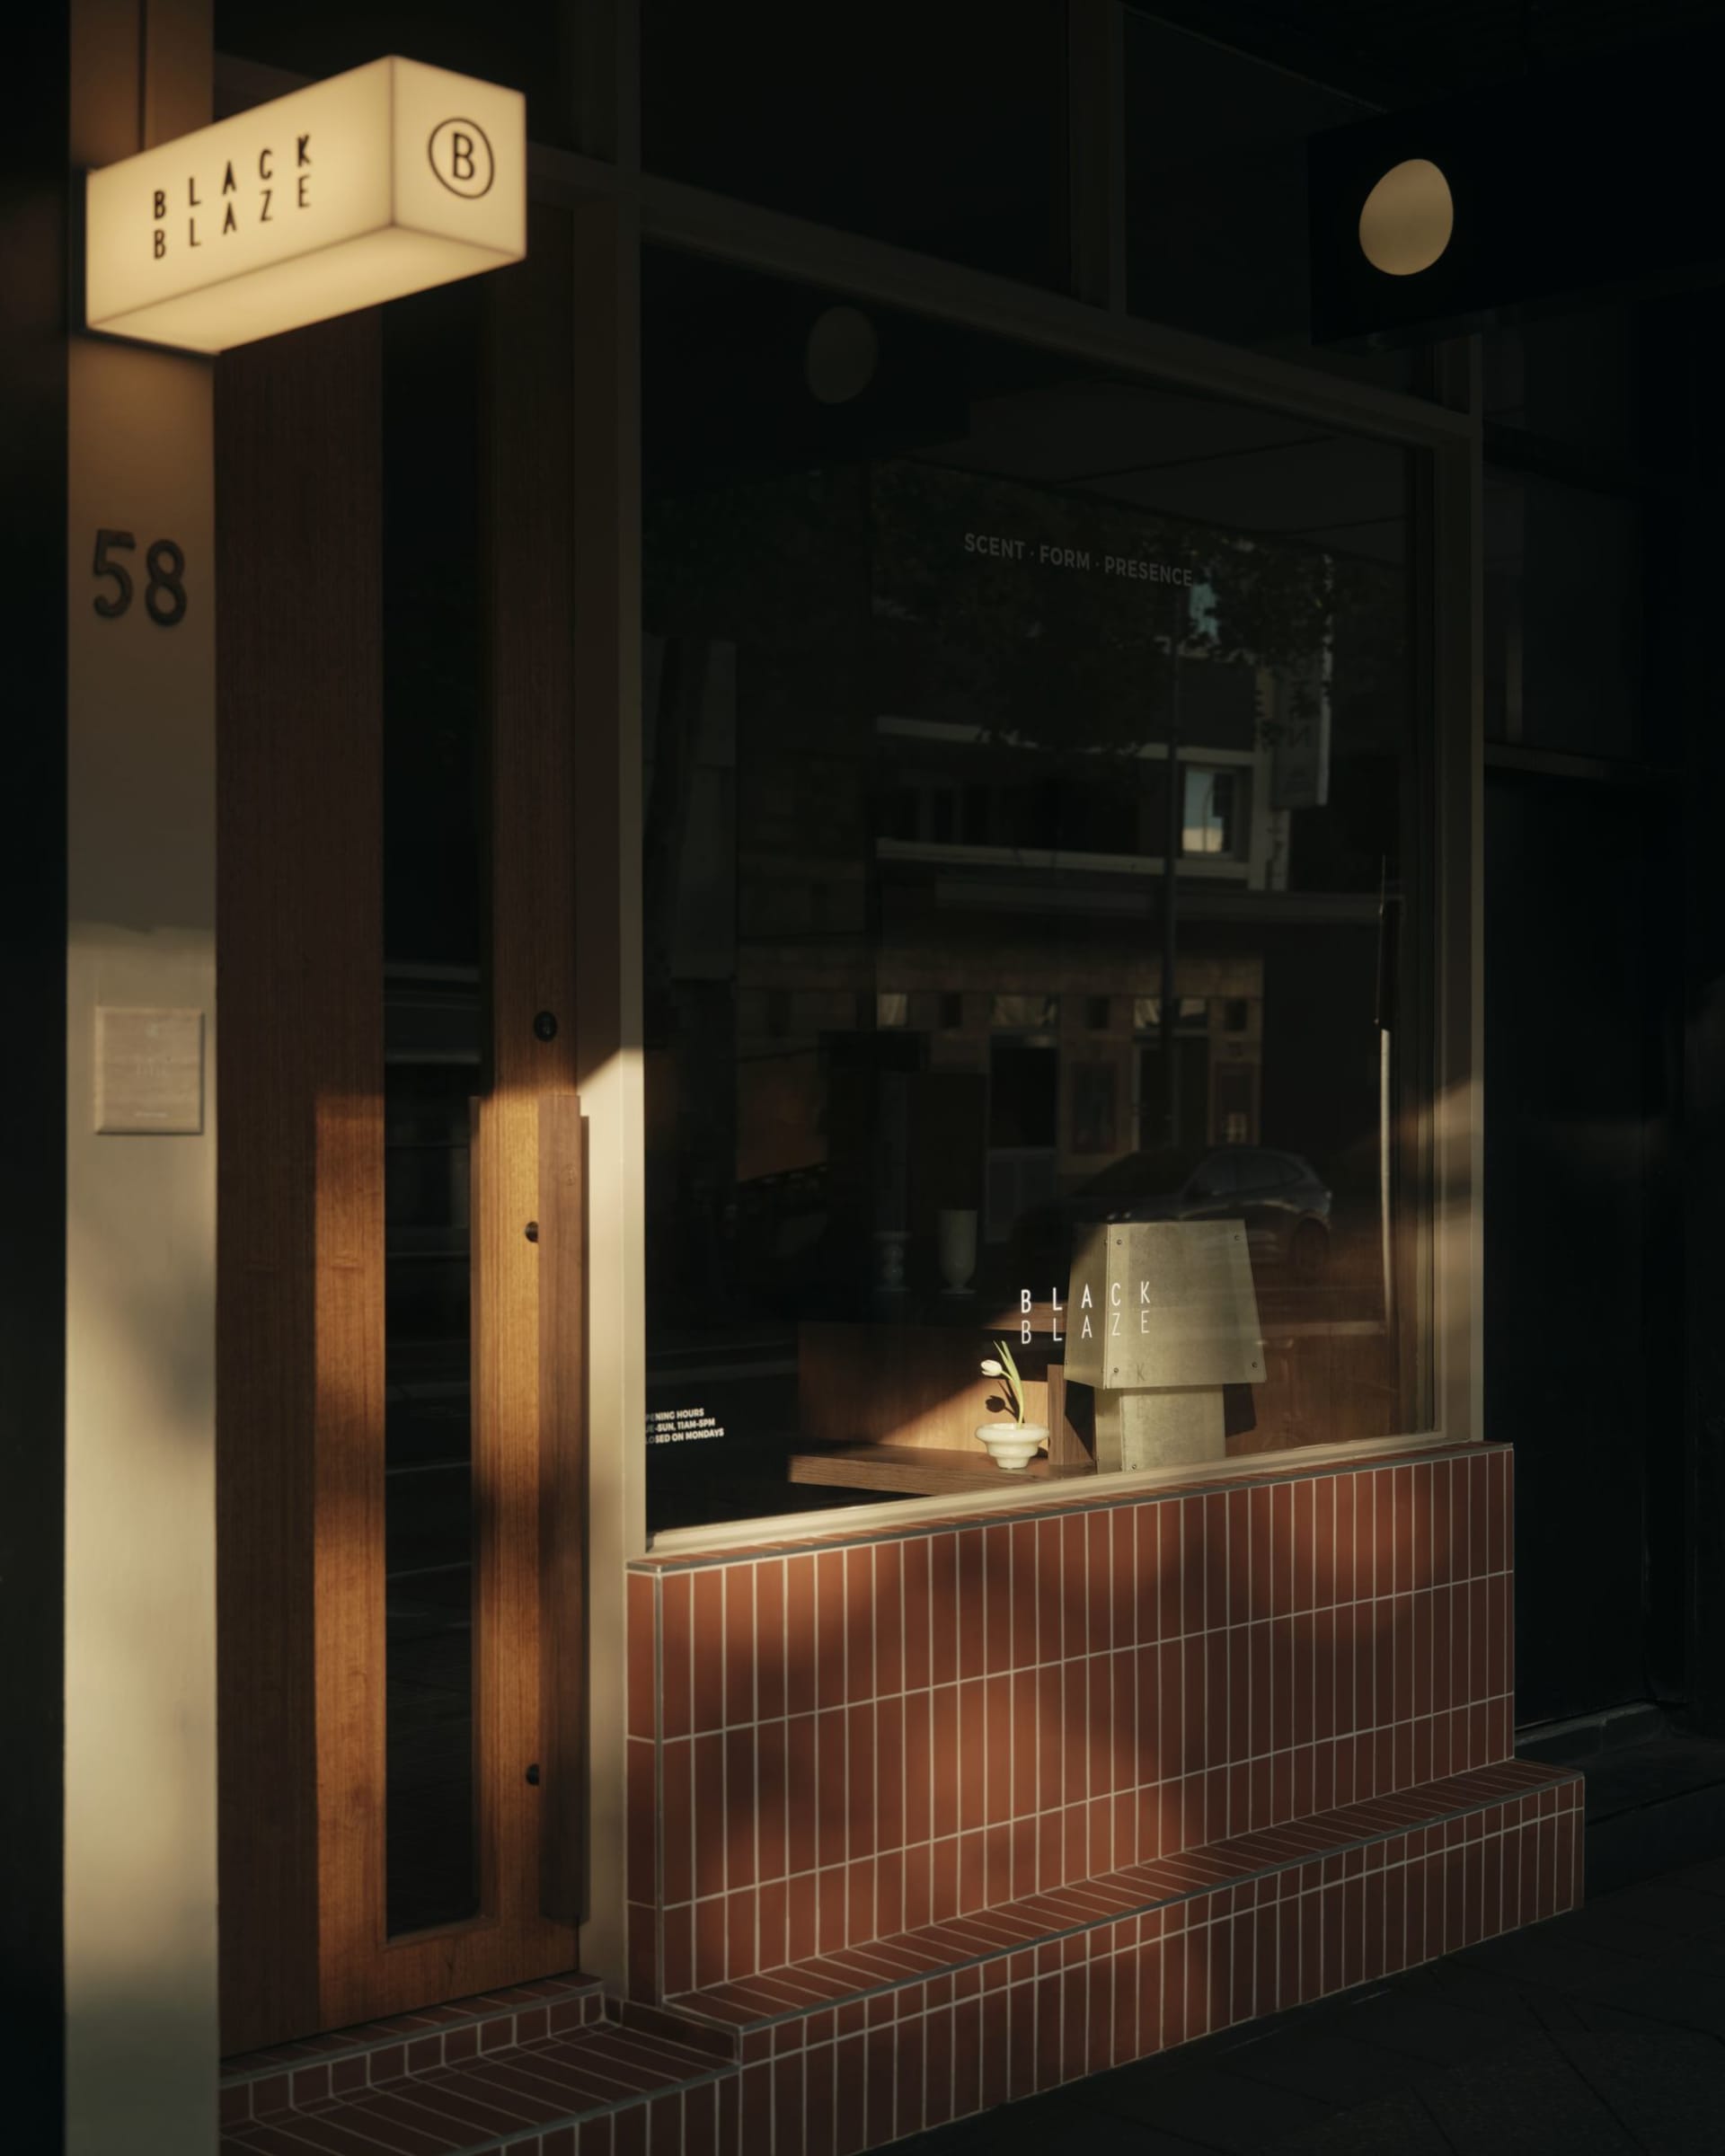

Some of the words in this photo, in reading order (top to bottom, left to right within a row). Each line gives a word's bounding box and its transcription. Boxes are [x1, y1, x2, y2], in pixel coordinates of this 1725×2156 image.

[153, 134, 311, 220] BLACK
[452, 132, 475, 181] B
[153, 175, 311, 261] BLAZE
[93, 528, 187, 627] 58
[963, 532, 1026, 561] SCENT
[1039, 544, 1091, 571] FORM
[1104, 556, 1193, 587] PRESENCE
[1021, 1281, 1150, 1313] BLACK
[1021, 1310, 1150, 1344] BLAZE
[672, 1431, 684, 1442] ON
[686, 1427, 725, 1439] MONDAYS
[677, 1408, 704, 1419] HOURS
